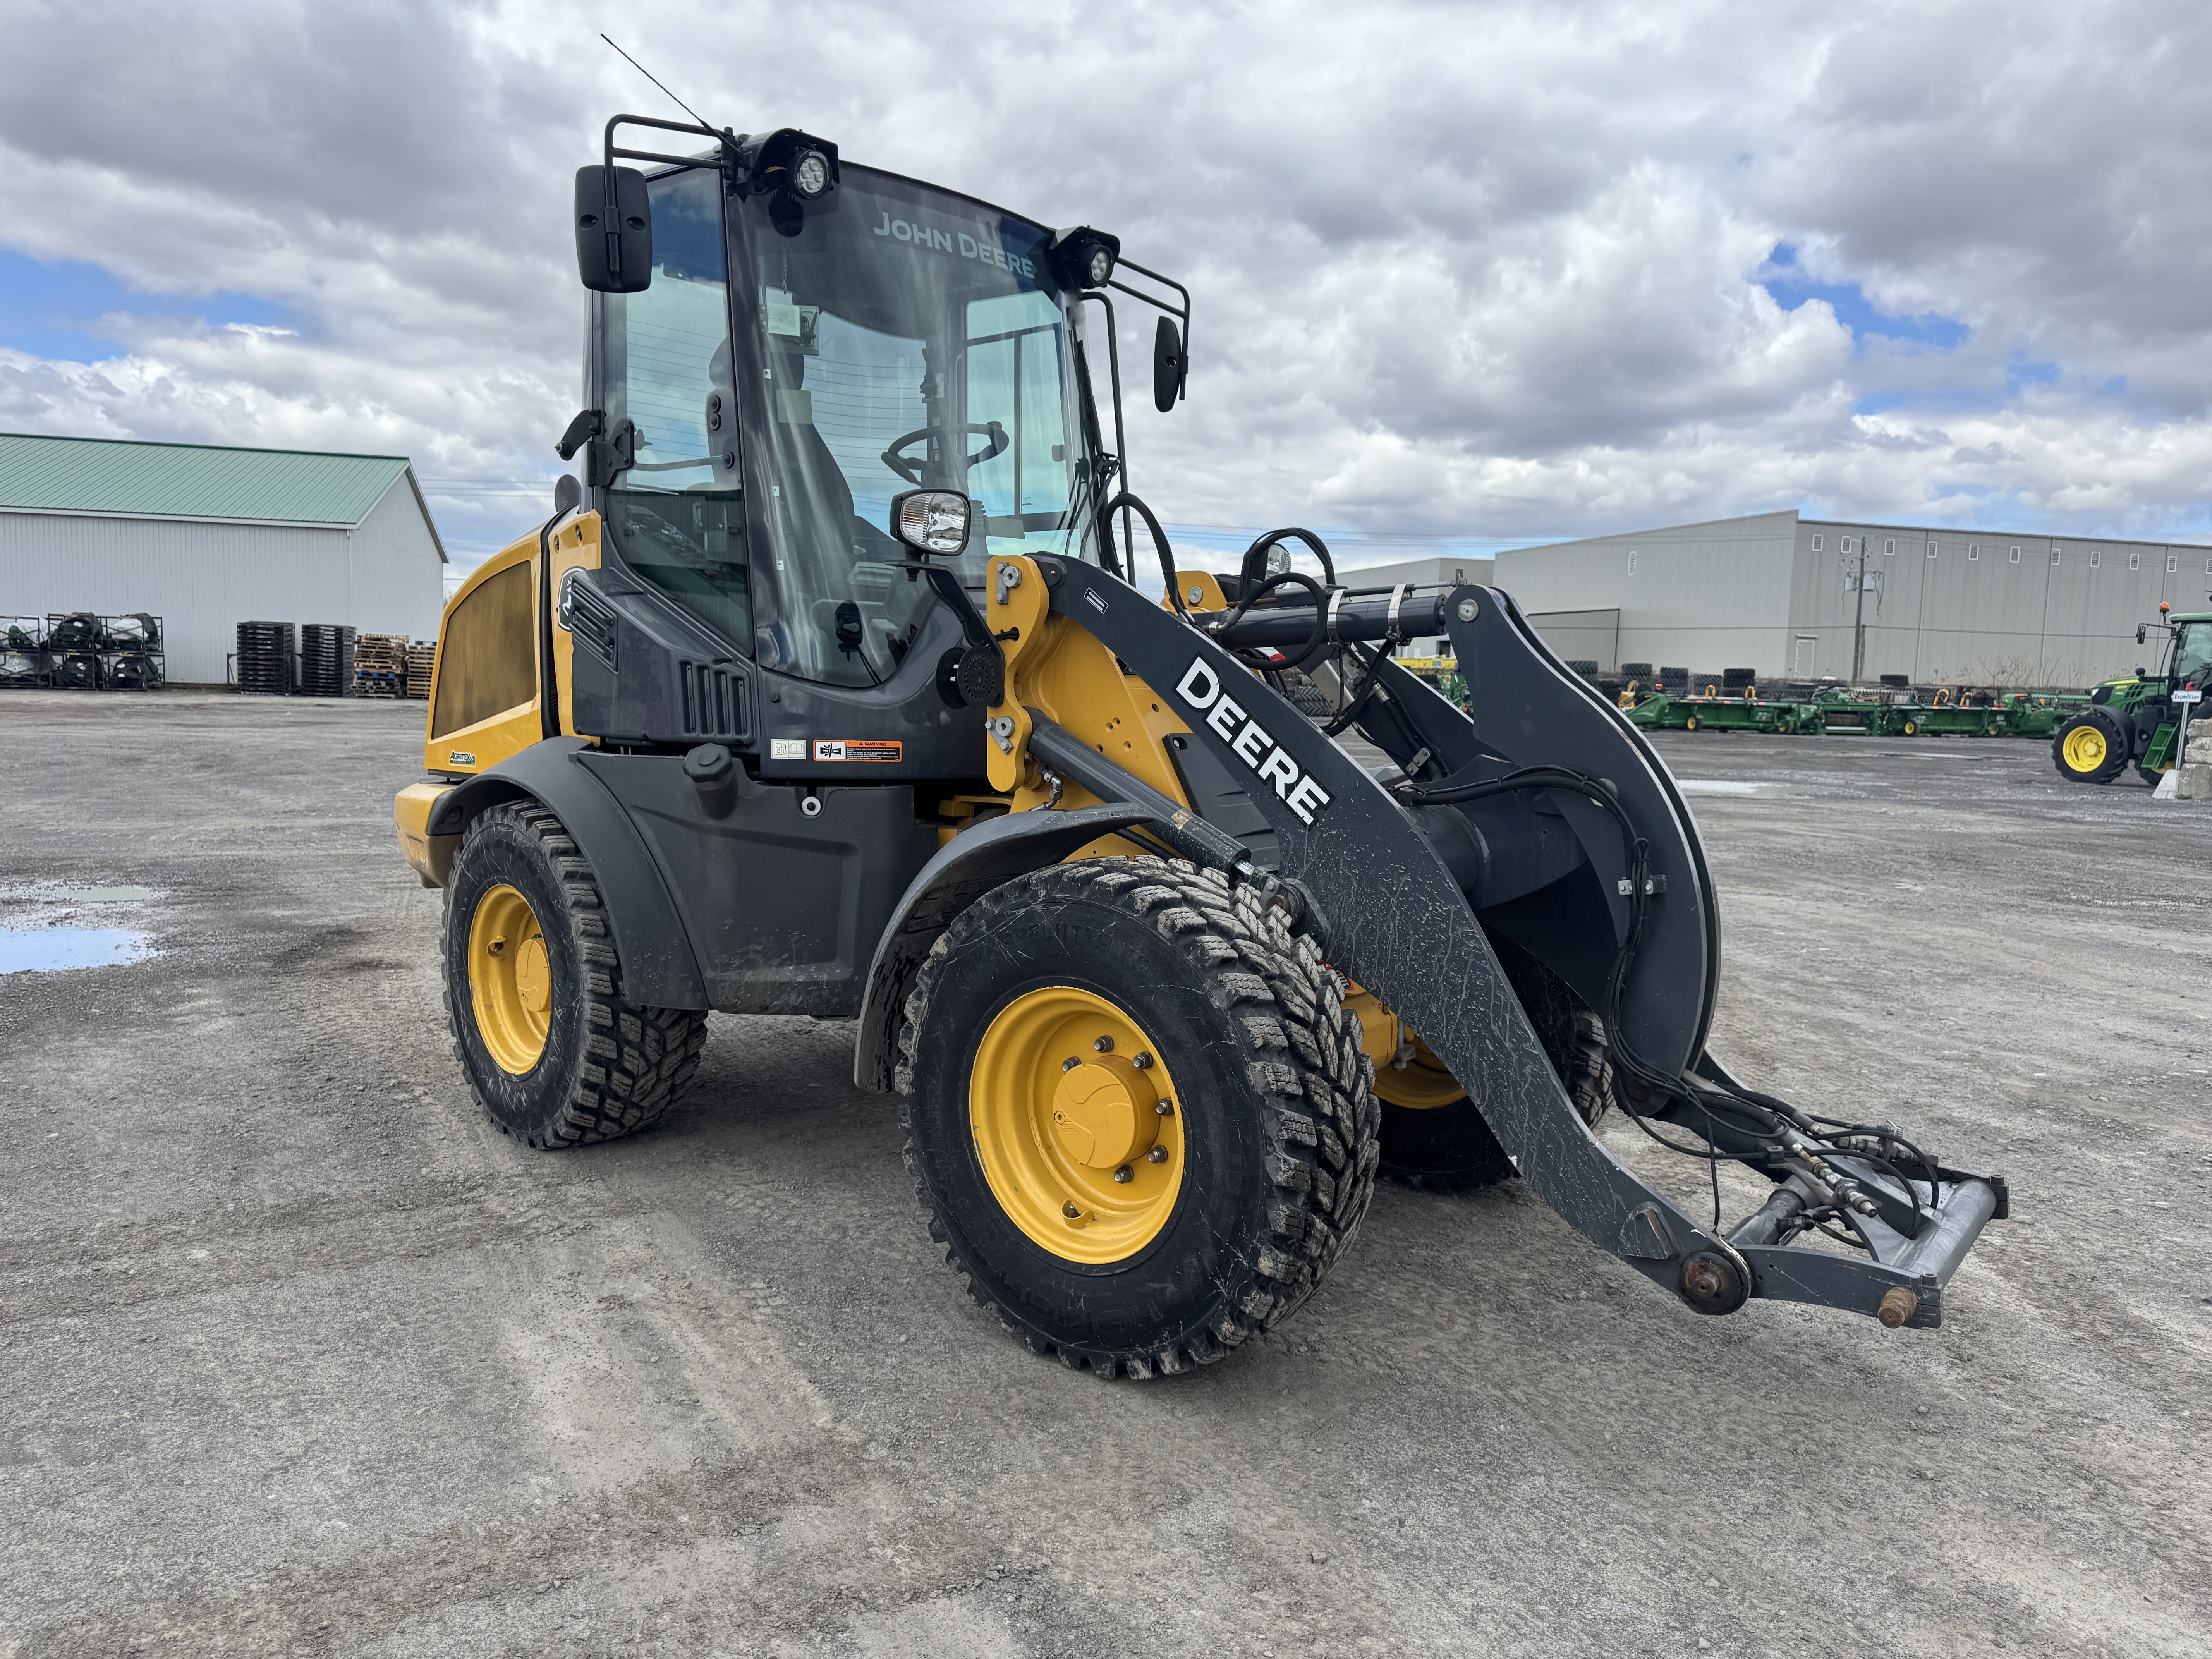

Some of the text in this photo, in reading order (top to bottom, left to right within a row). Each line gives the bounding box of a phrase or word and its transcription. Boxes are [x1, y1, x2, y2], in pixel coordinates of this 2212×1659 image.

[874, 212, 1034, 279] JOHN DEERE
[450, 751, 470, 760] AGRITEX
[1176, 657, 1330, 825] DEERE
